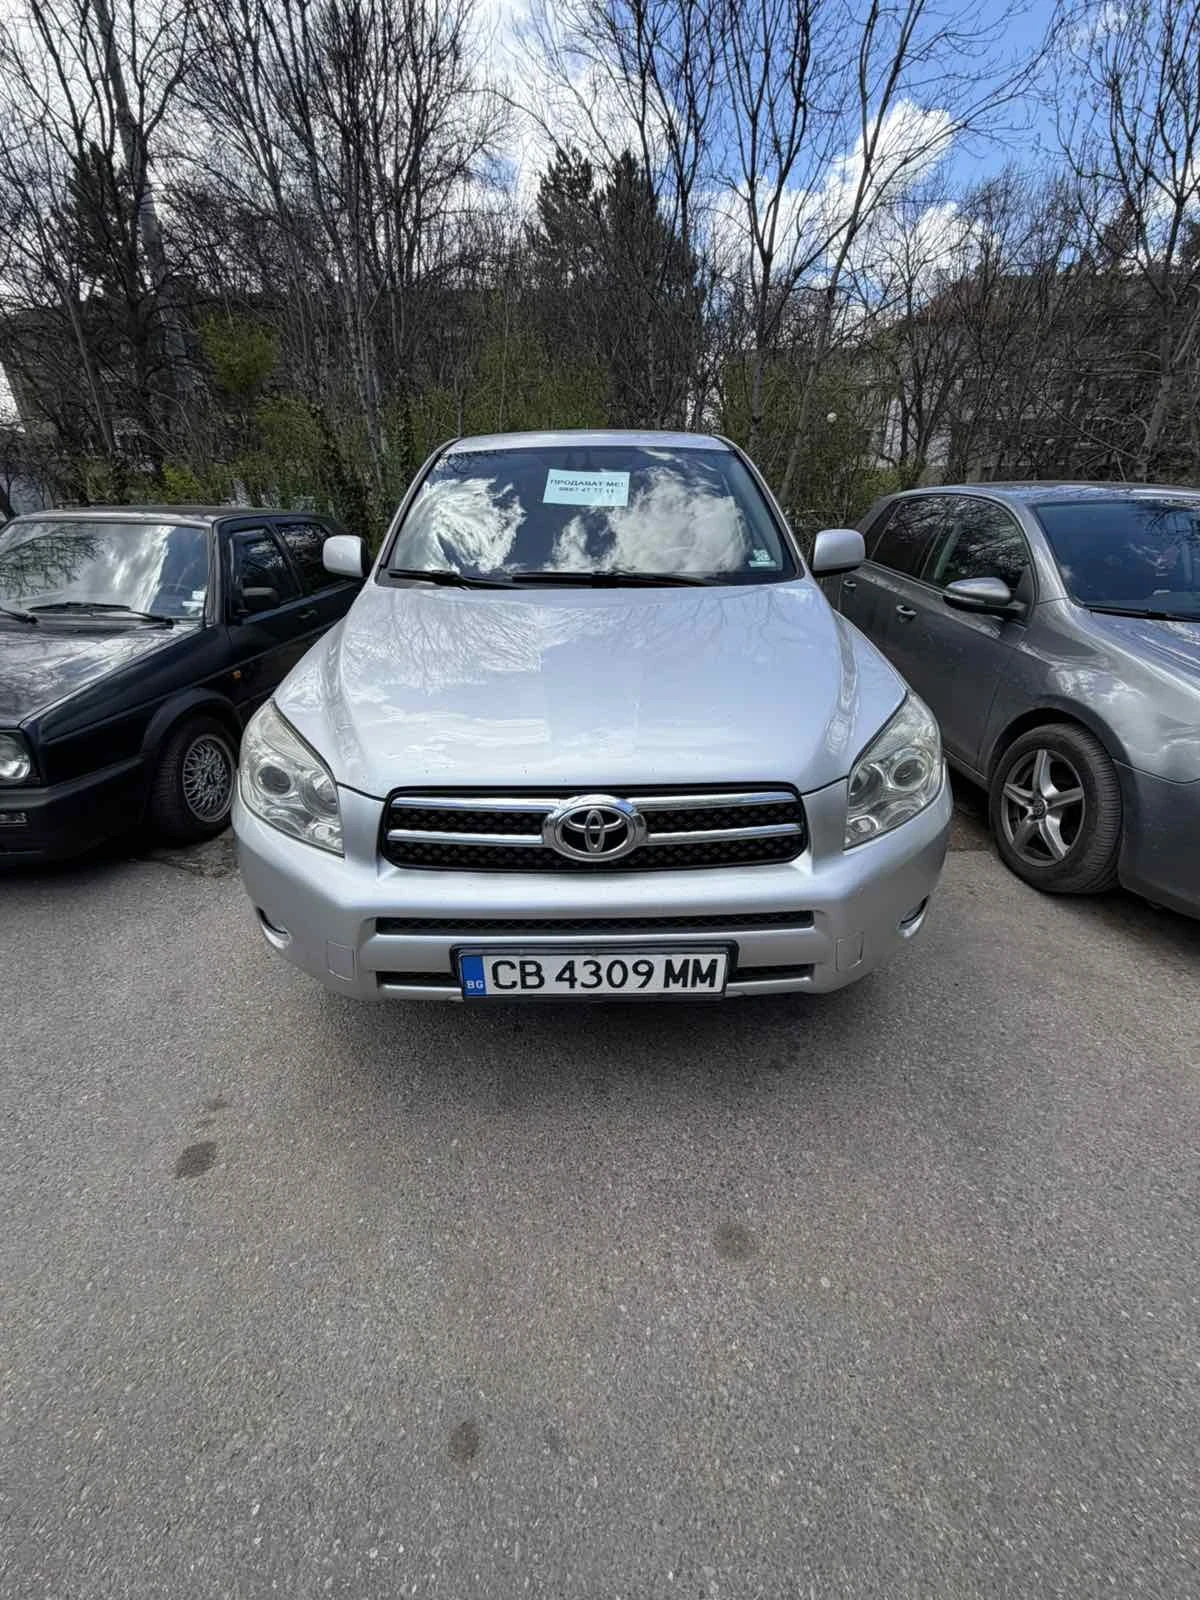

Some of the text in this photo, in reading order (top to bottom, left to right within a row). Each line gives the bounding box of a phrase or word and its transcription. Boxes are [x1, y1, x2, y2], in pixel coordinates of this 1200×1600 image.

[491, 958, 718, 990] CB 4309 MM
[466, 980, 484, 990] BG
